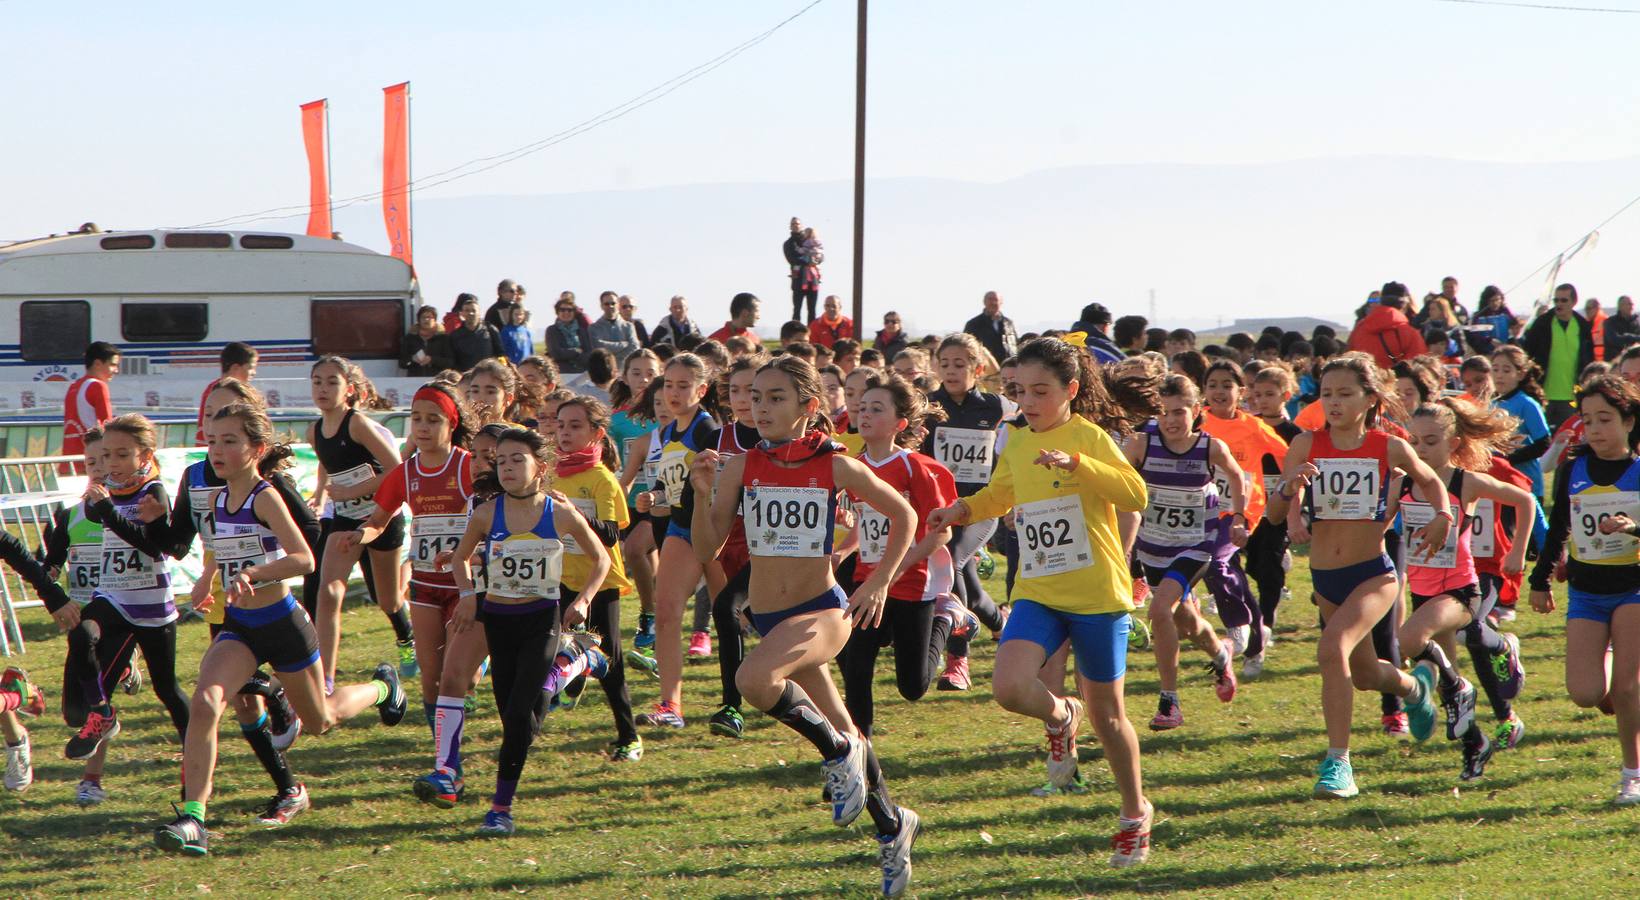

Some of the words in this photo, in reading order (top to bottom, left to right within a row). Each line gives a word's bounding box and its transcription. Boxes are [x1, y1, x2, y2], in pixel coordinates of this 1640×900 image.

[32, 365, 67, 382] AYUDA
[940, 443, 987, 464] 1044
[661, 463, 688, 486] 172
[1315, 471, 1373, 495] 1021
[193, 510, 217, 536] 71
[751, 500, 819, 529] 1080
[1153, 505, 1196, 528] 753
[1025, 518, 1074, 551] 962
[102, 549, 143, 575] 754
[502, 556, 547, 580] 951
[76, 565, 100, 588] 65
